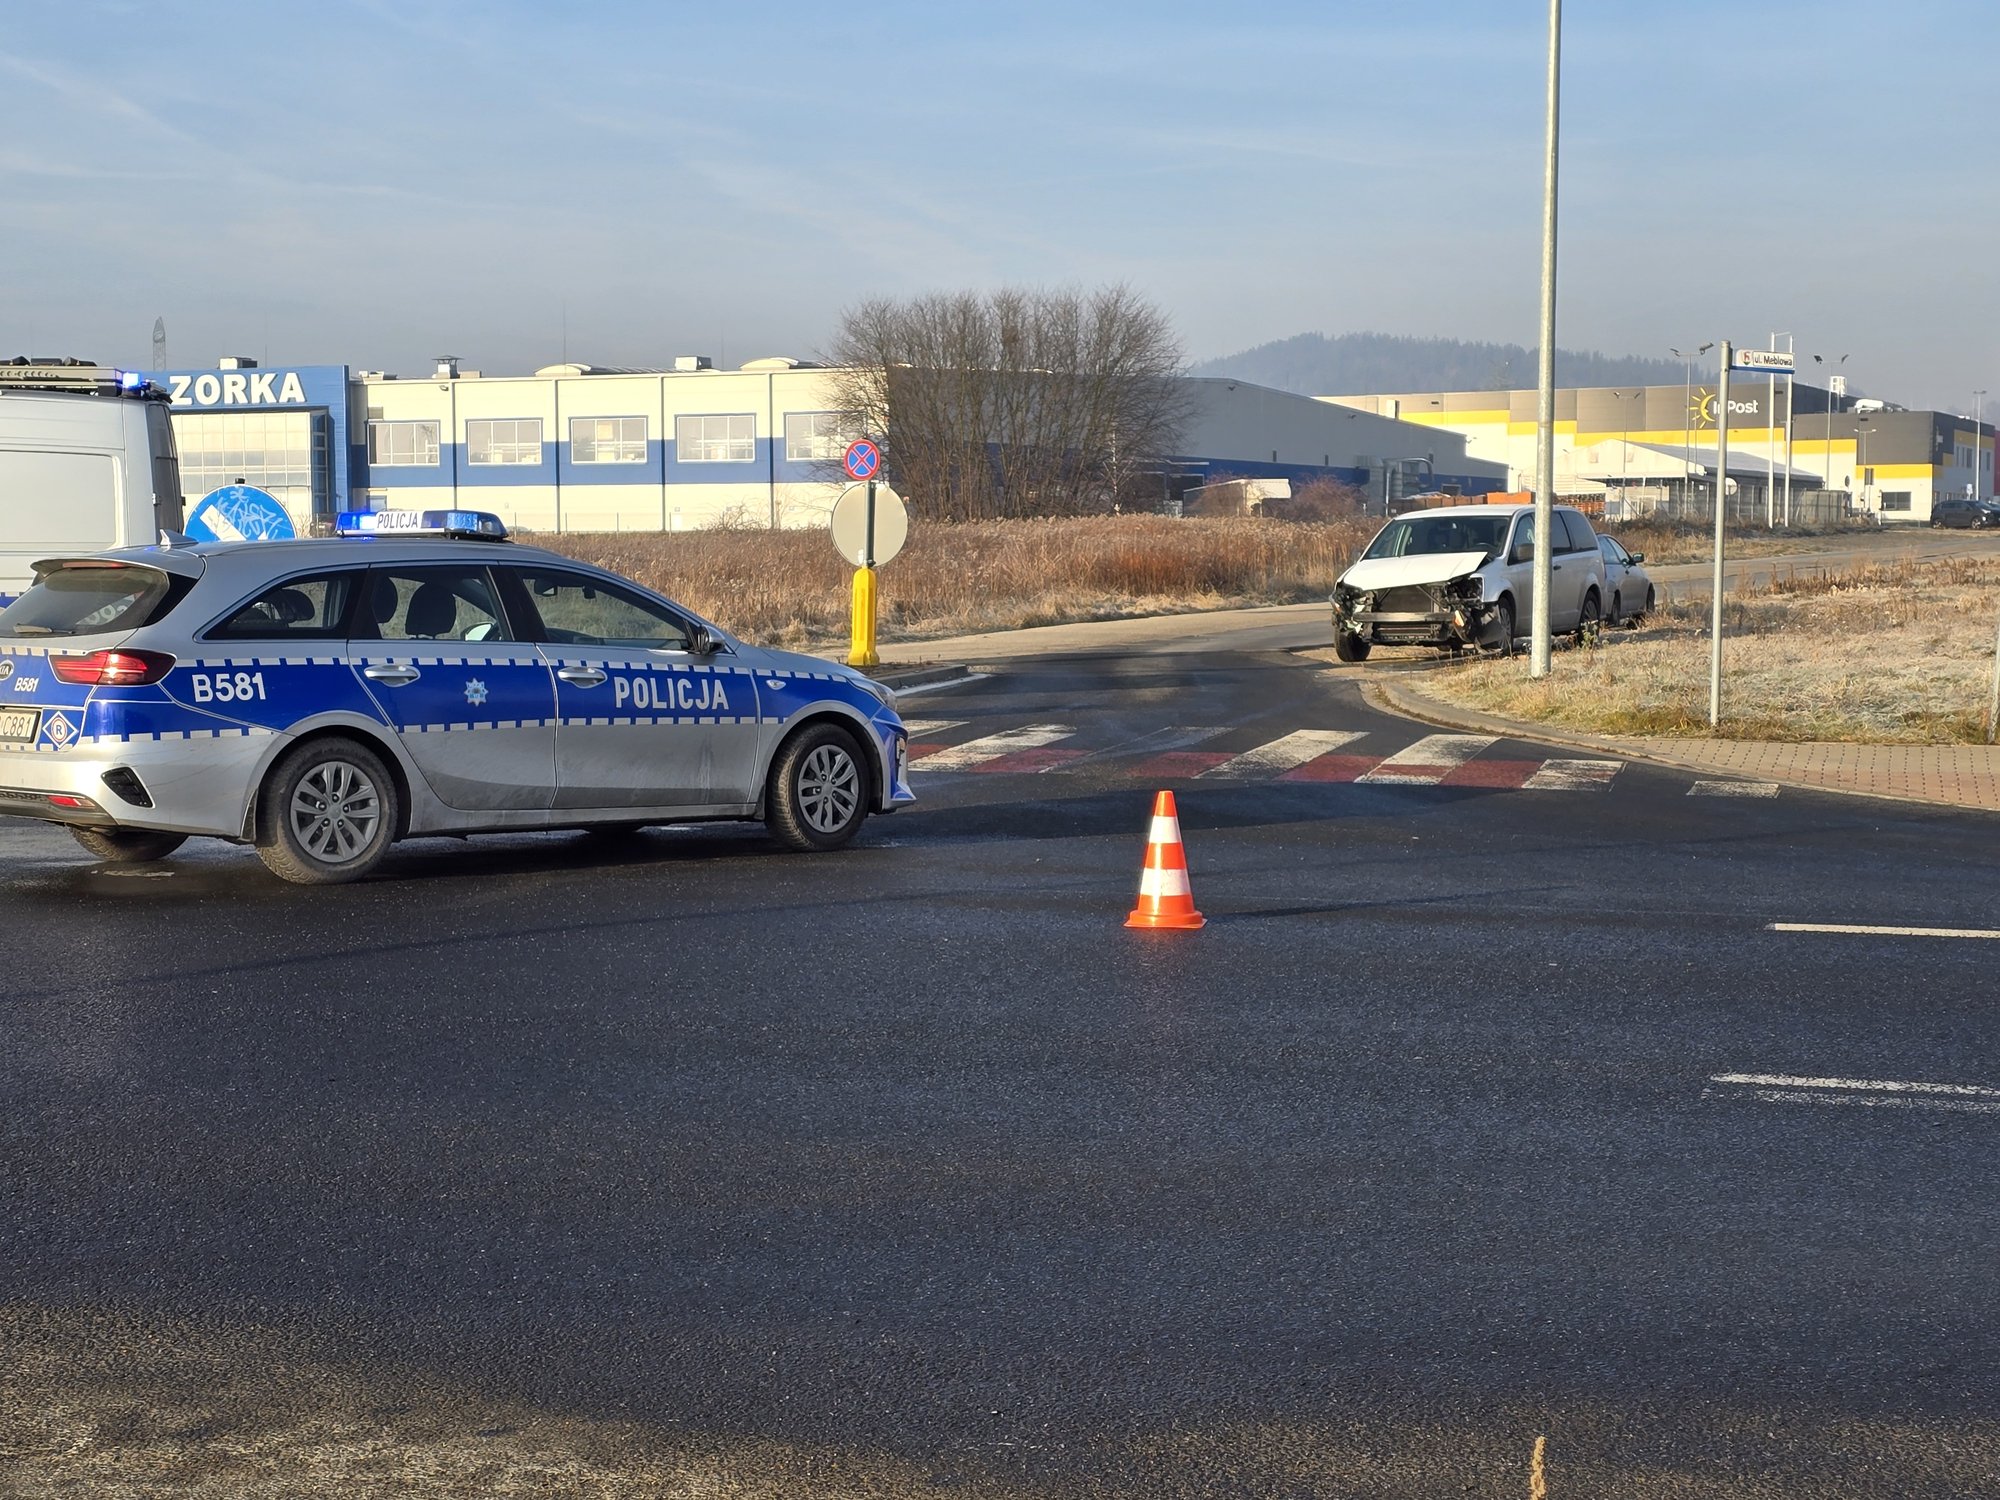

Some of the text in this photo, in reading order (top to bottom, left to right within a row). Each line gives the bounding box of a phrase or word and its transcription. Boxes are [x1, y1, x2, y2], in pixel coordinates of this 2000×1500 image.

[1754, 355, 1792, 366] ul. Meblowa
[169, 372, 306, 406] ZORKA
[377, 512, 418, 528] POLICJA
[14, 677, 39, 692] B581
[192, 672, 266, 703] B581
[613, 676, 729, 711] POLICJA
[55, 725, 62, 735] R
